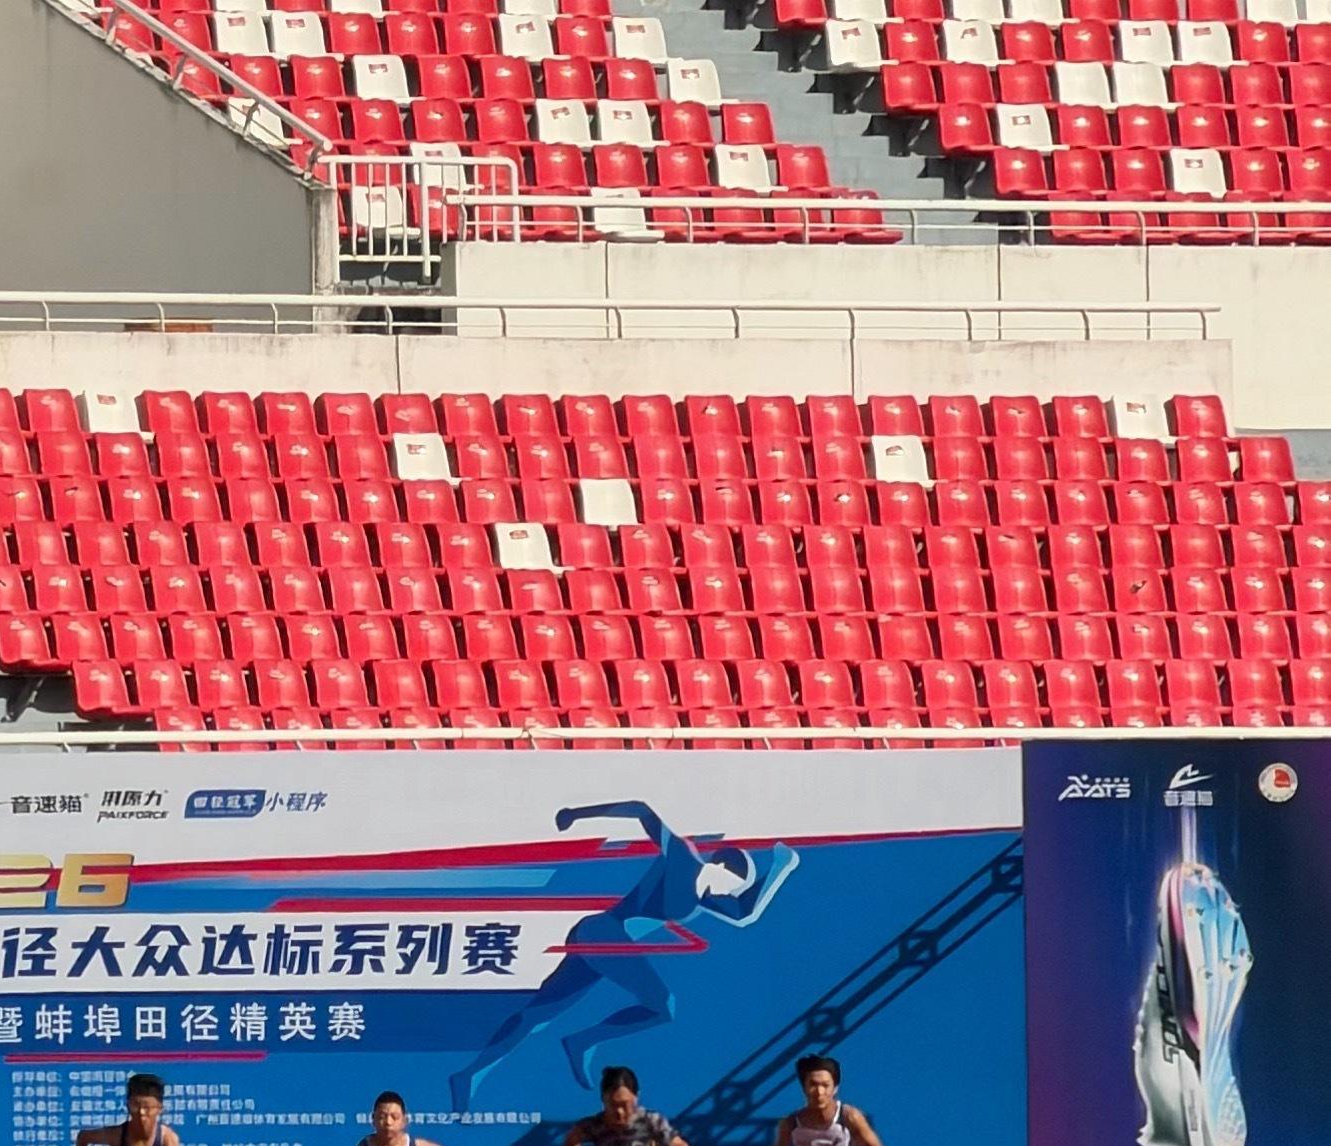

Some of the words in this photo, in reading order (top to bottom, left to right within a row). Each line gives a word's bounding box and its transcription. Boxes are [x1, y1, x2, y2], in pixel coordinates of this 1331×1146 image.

[10, 795, 83, 814] 音速猫
[266, 791, 328, 812] 小程序
